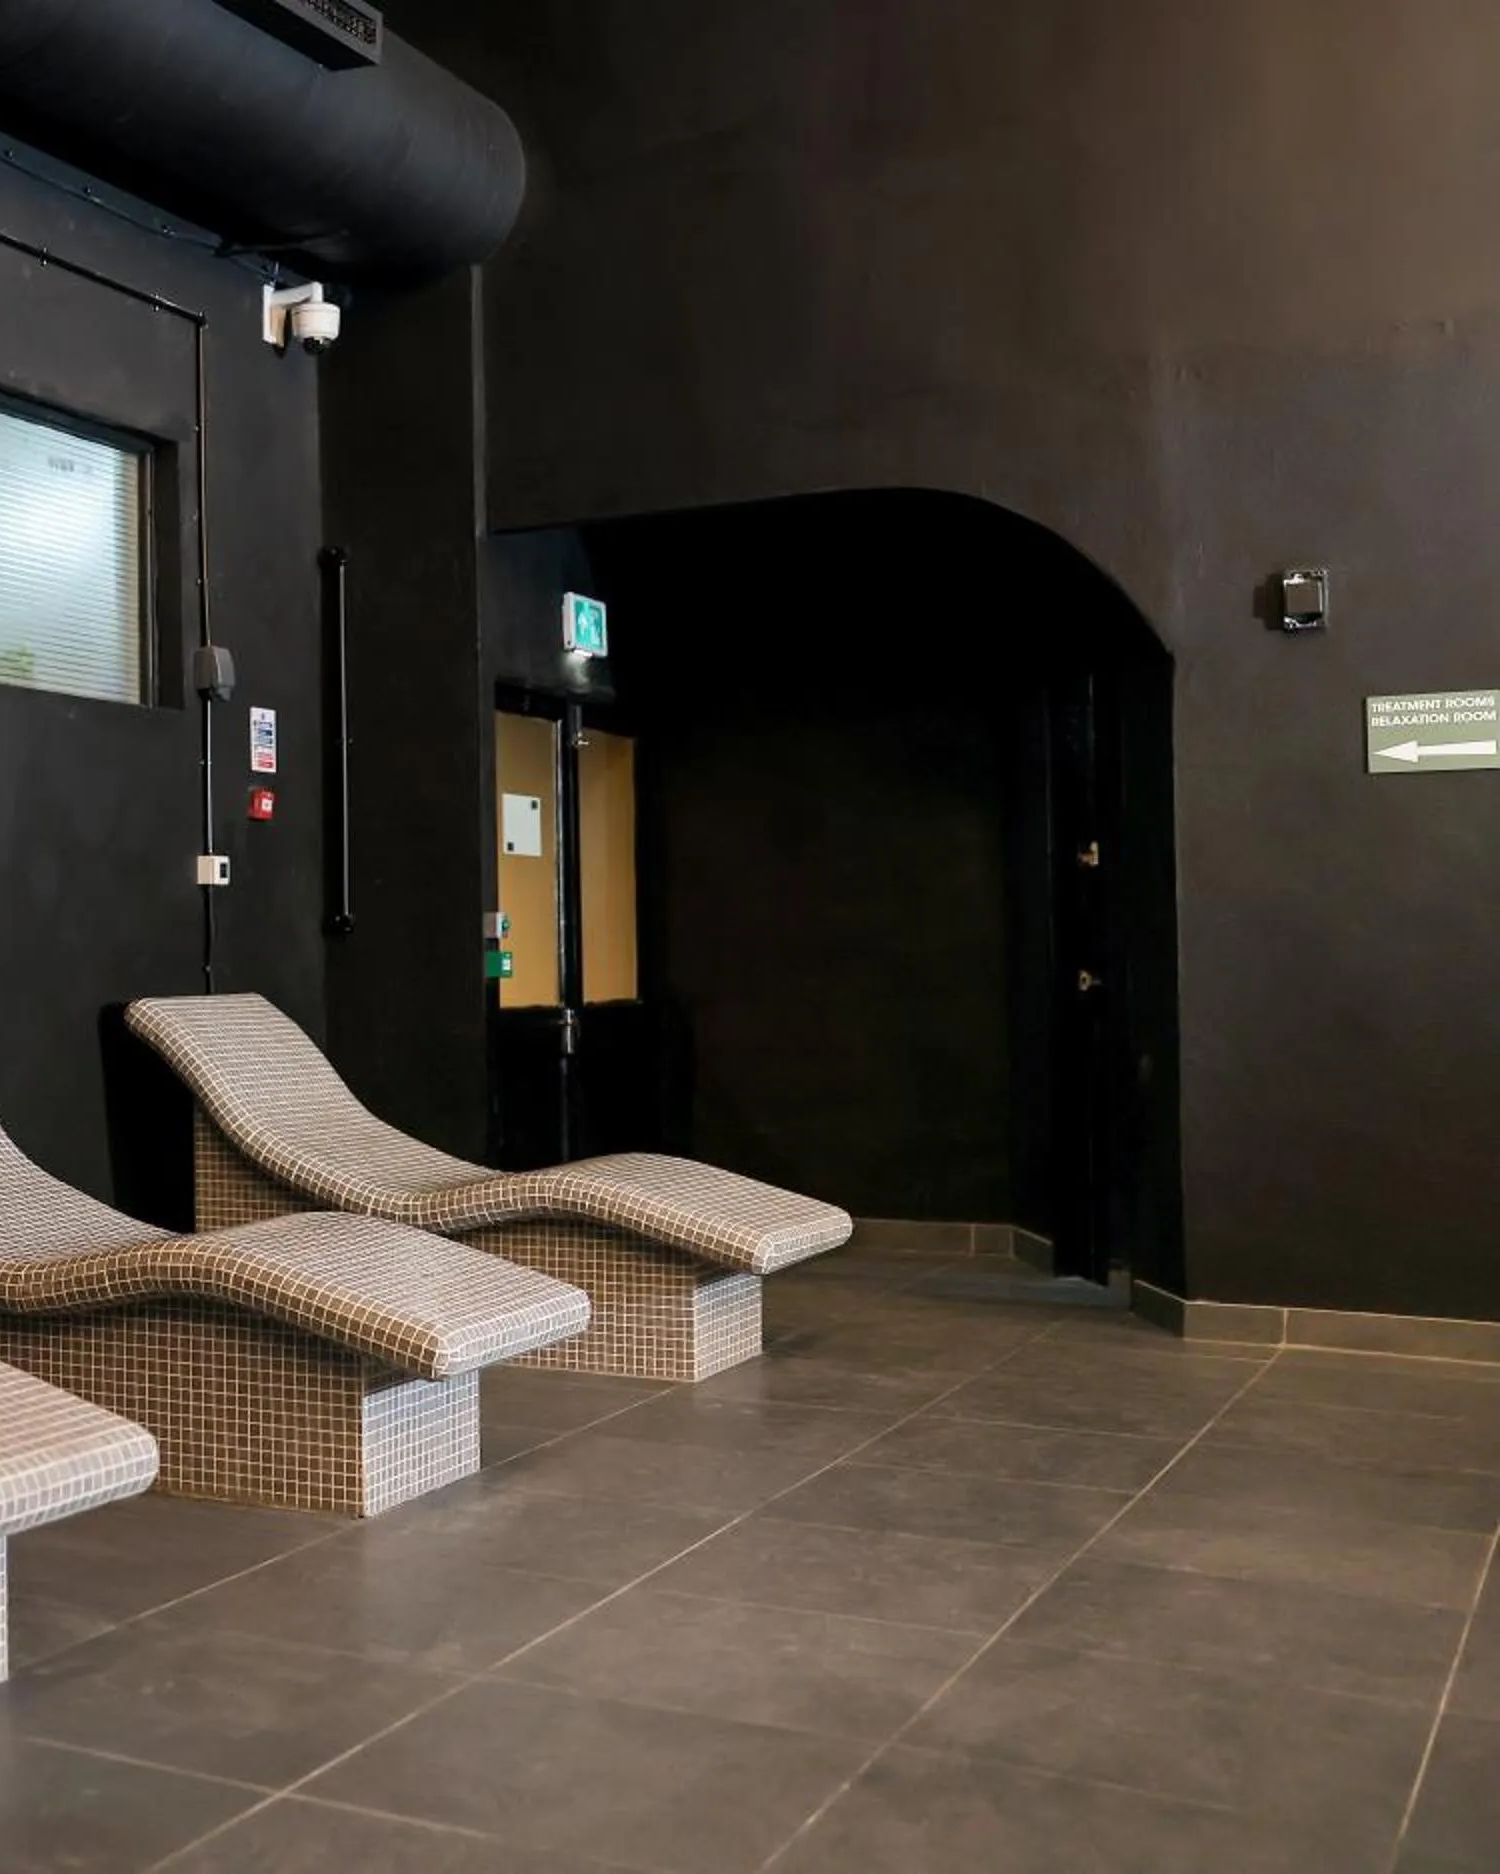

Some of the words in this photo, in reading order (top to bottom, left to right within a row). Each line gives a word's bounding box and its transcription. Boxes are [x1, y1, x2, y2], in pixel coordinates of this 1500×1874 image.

[1371, 699, 1441, 713] TREATMENT
[1445, 696, 1495, 709] ROOMS
[1371, 713, 1449, 727] RELAXATION
[1453, 710, 1497, 723] ROOM
